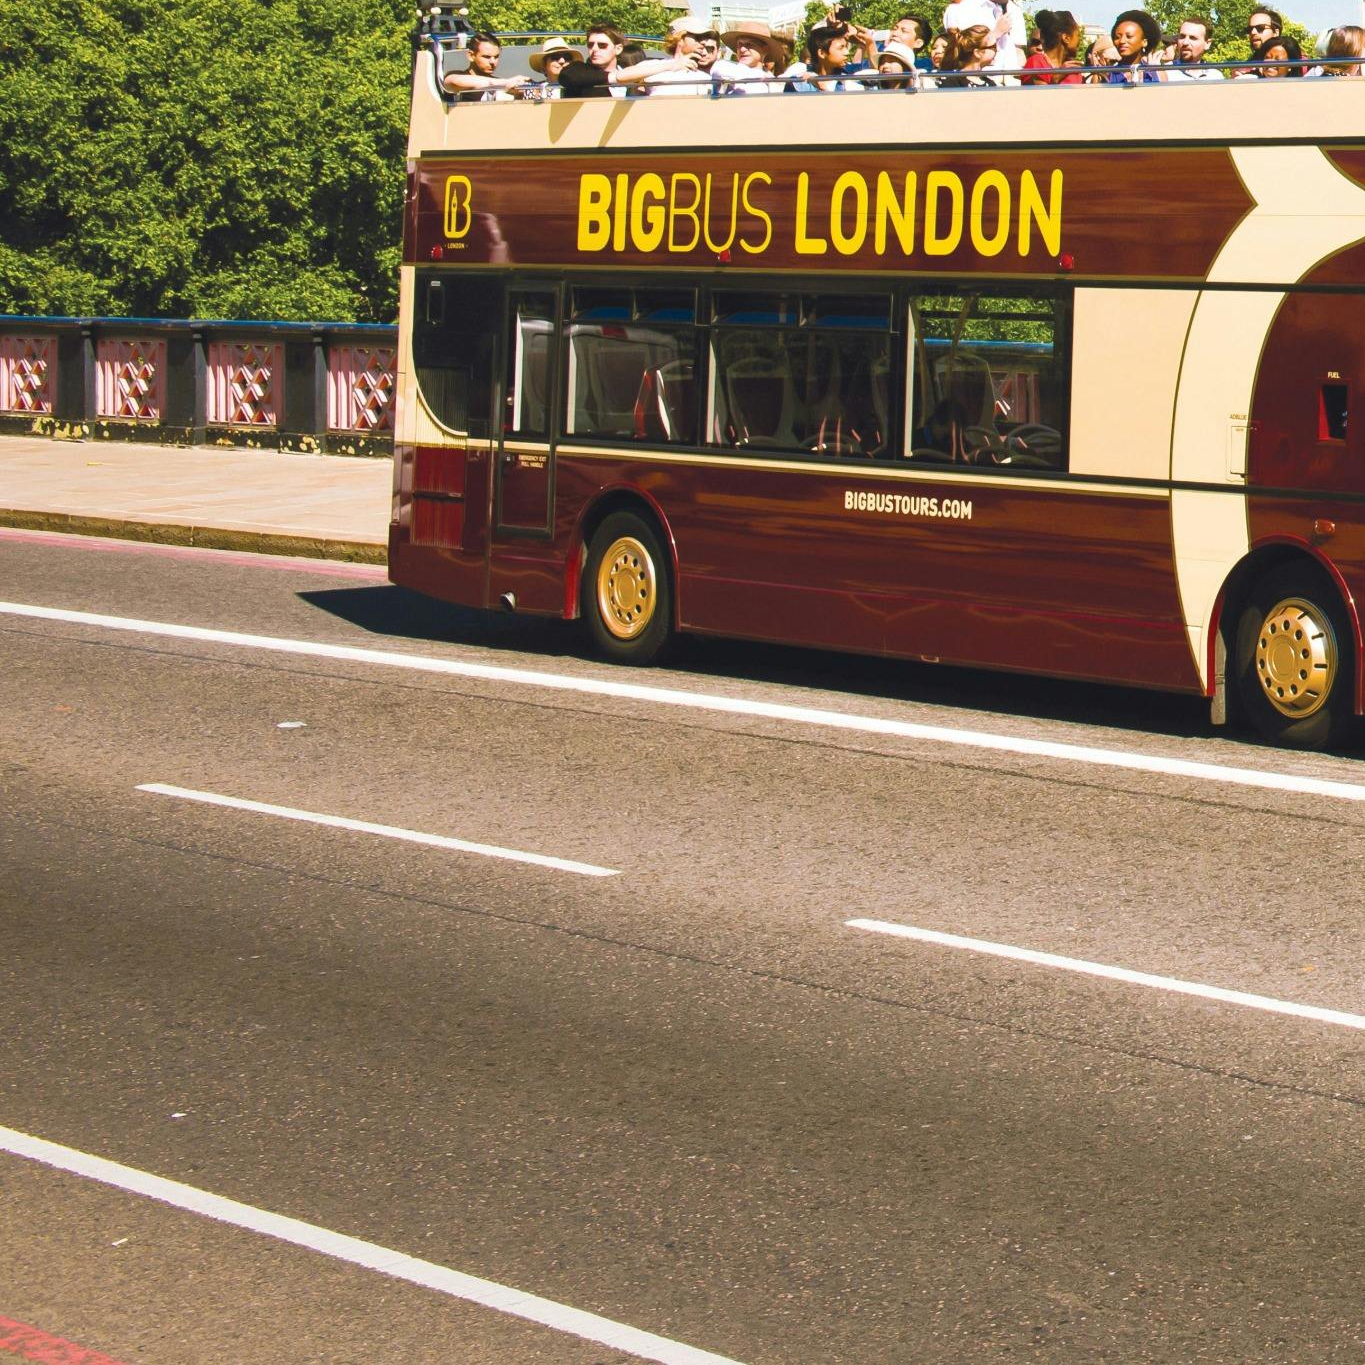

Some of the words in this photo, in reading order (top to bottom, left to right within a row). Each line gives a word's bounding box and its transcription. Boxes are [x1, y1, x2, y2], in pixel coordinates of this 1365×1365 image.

[795, 169, 1063, 257] LONDON
[1327, 371, 1341, 379] FUEL
[844, 490, 972, 520] BIGBUSTOURS.COM
